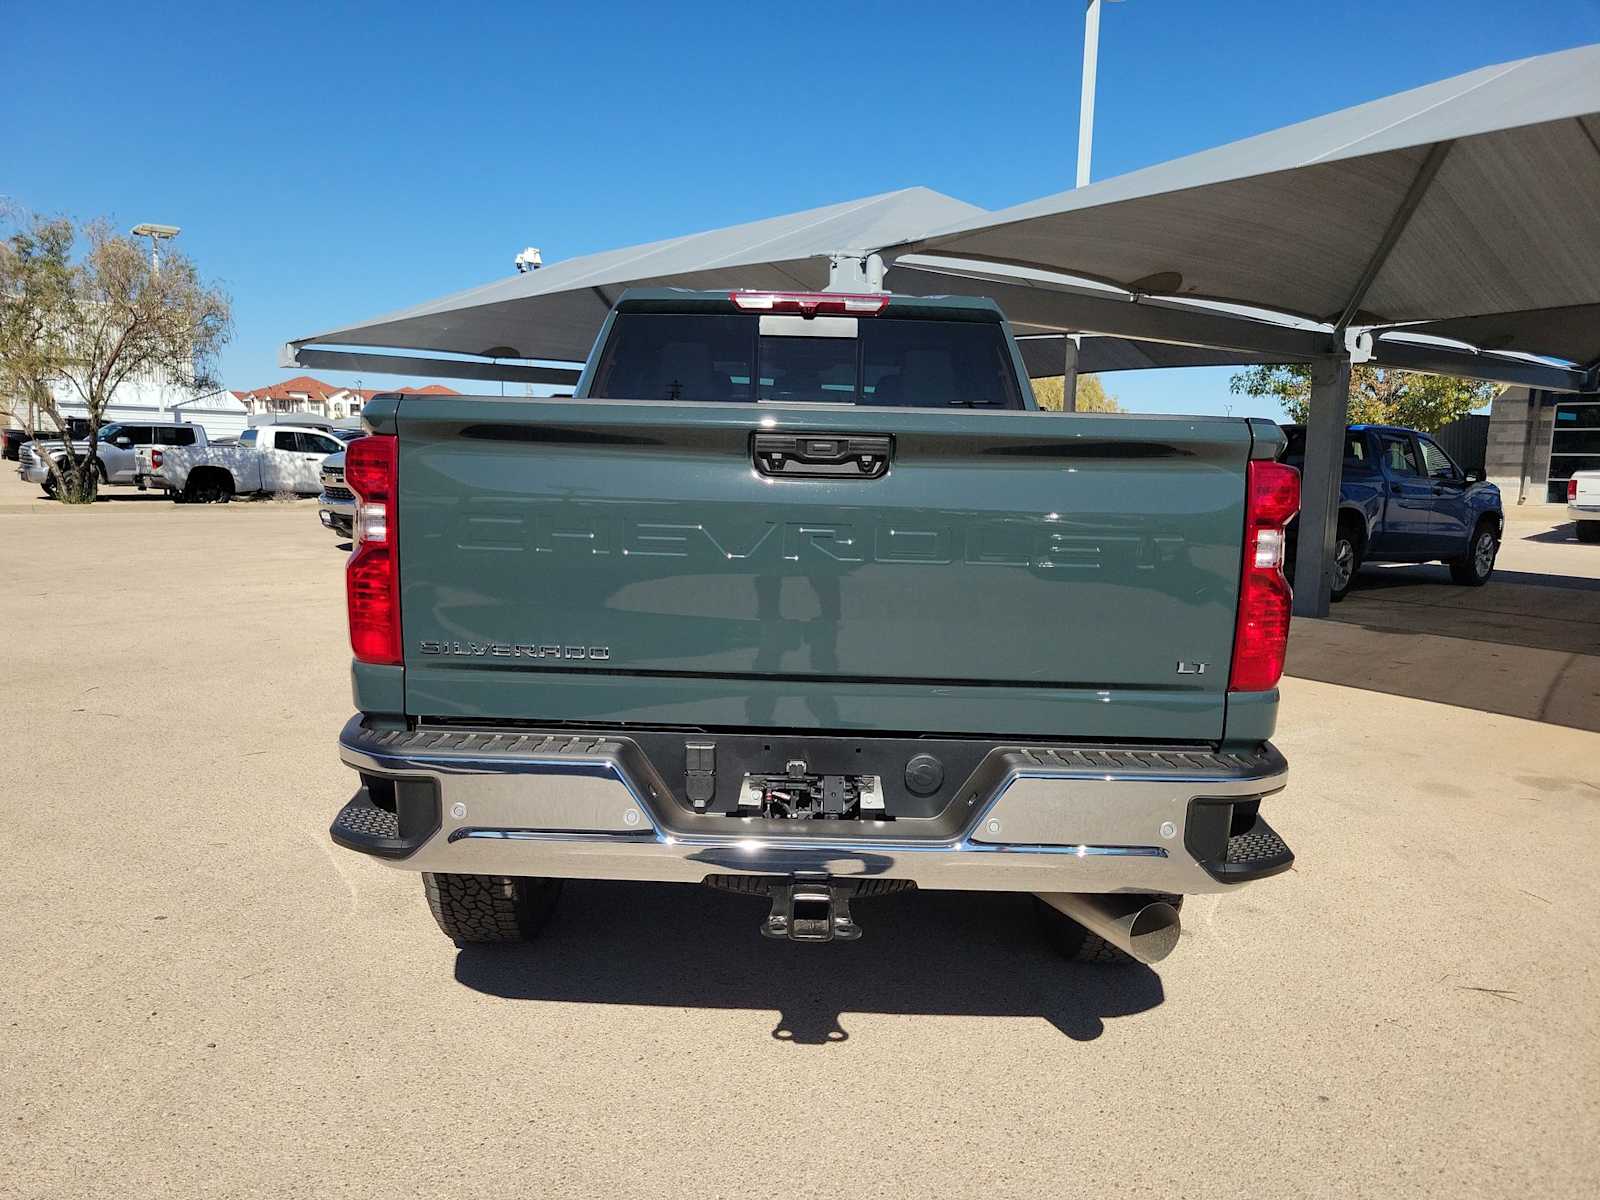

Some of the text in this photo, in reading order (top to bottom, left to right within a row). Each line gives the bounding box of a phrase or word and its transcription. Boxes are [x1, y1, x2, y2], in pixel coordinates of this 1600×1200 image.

[454, 513, 1188, 569] CHEVROLET
[419, 640, 611, 661] SILVERADO
[1176, 660, 1210, 675] LT
